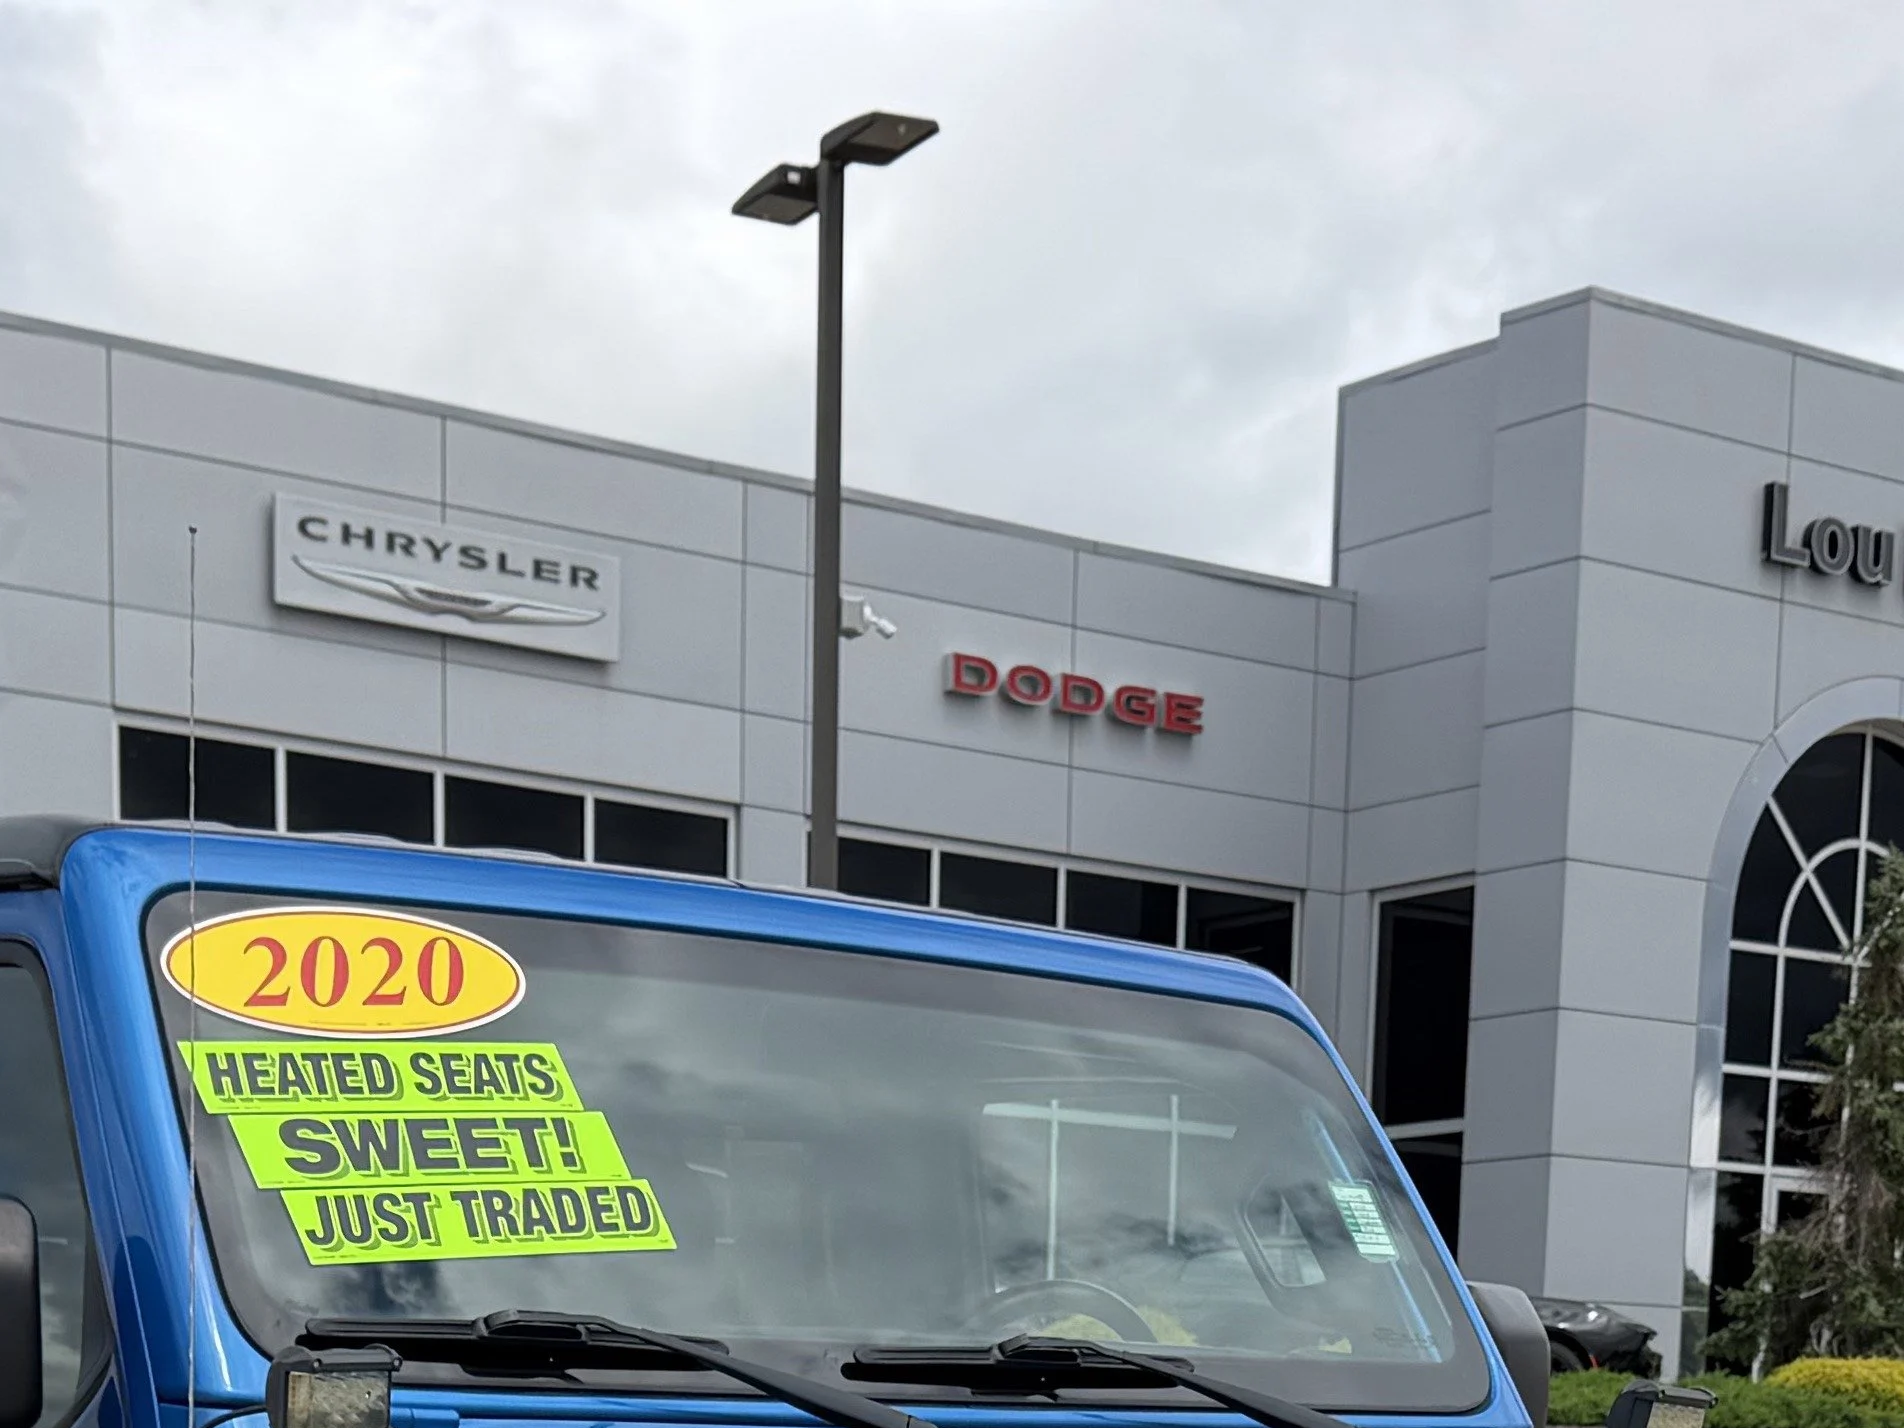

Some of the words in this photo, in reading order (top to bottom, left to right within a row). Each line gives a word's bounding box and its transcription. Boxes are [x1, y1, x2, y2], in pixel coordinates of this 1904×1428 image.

[297, 515, 601, 592] CHRYSLER
[1762, 481, 1895, 588] Lou
[944, 651, 1205, 736] DODGE
[241, 935, 465, 1008] 2020
[204, 1050, 400, 1101] HEATED
[409, 1052, 560, 1100] SEATS
[278, 1116, 583, 1176] SWEET!
[304, 1190, 439, 1247] JUST
[451, 1185, 657, 1242] TRADED
